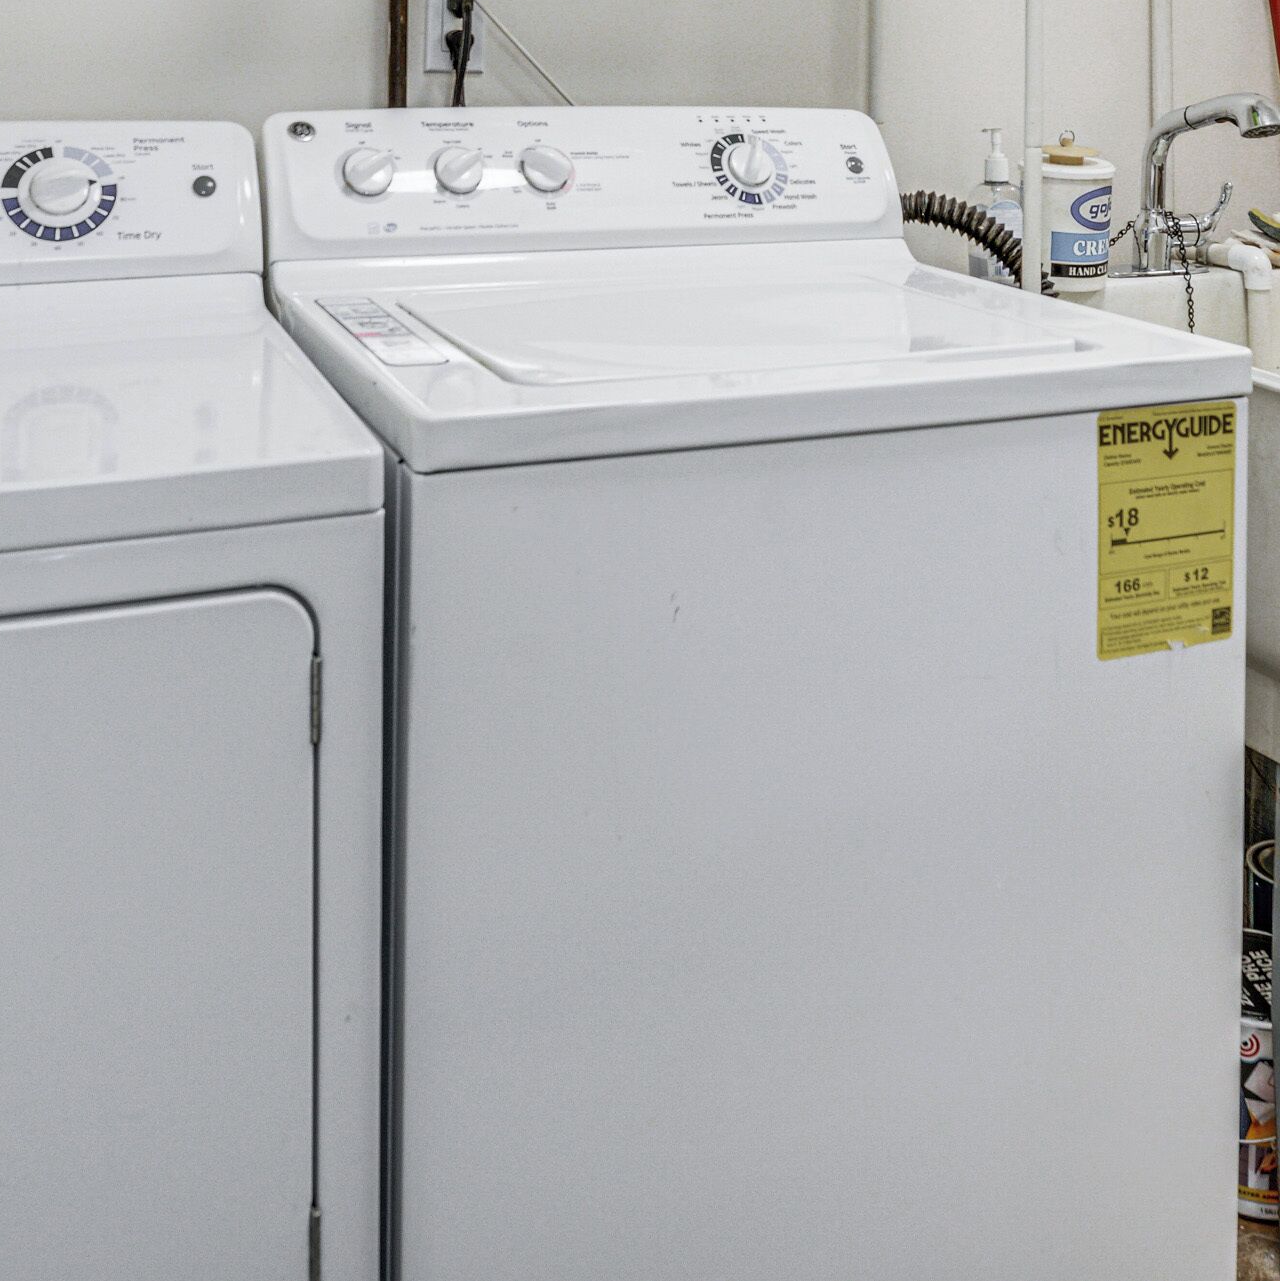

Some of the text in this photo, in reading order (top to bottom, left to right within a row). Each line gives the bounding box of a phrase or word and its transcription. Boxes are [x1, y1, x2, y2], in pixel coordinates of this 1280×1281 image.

[345, 121, 373, 130] Signal
[420, 120, 475, 129] Temperature
[516, 120, 549, 128] Options
[132, 135, 185, 145] Permanent
[132, 144, 159, 152] Press
[191, 163, 214, 171] Start
[1089, 196, 1112, 219] goj
[704, 212, 736, 220] Permanent
[117, 230, 162, 241] Time Dry
[1068, 266, 1096, 276] HAND
[1099, 413, 1234, 447] ENERGYGUIDE
[1107, 507, 1140, 529] $18
[1114, 578, 1141, 594] 166
